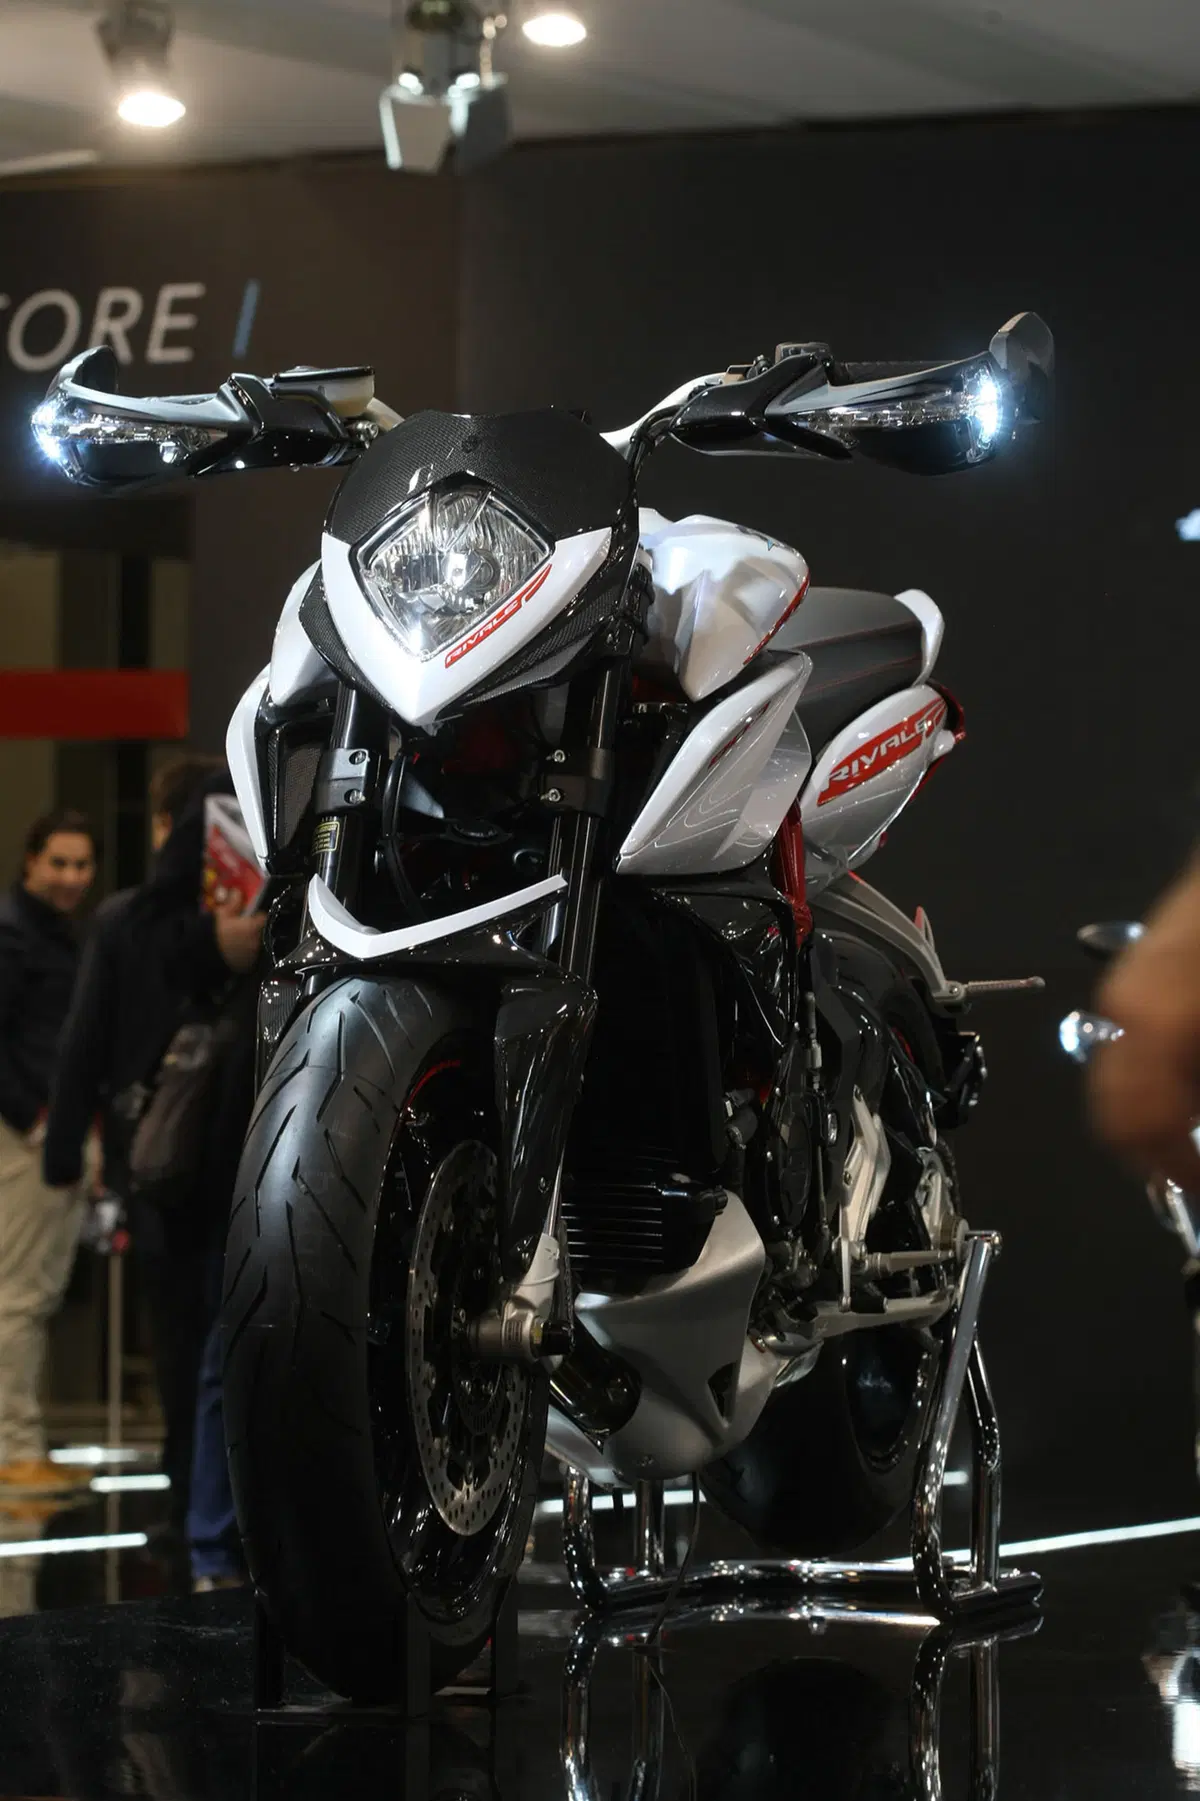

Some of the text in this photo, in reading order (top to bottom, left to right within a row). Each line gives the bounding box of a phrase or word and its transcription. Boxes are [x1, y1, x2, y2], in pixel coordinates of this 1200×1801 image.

[0, 282, 206, 372] ORE
[446, 599, 521, 664] RIVALE
[817, 717, 931, 793] RIVALE
